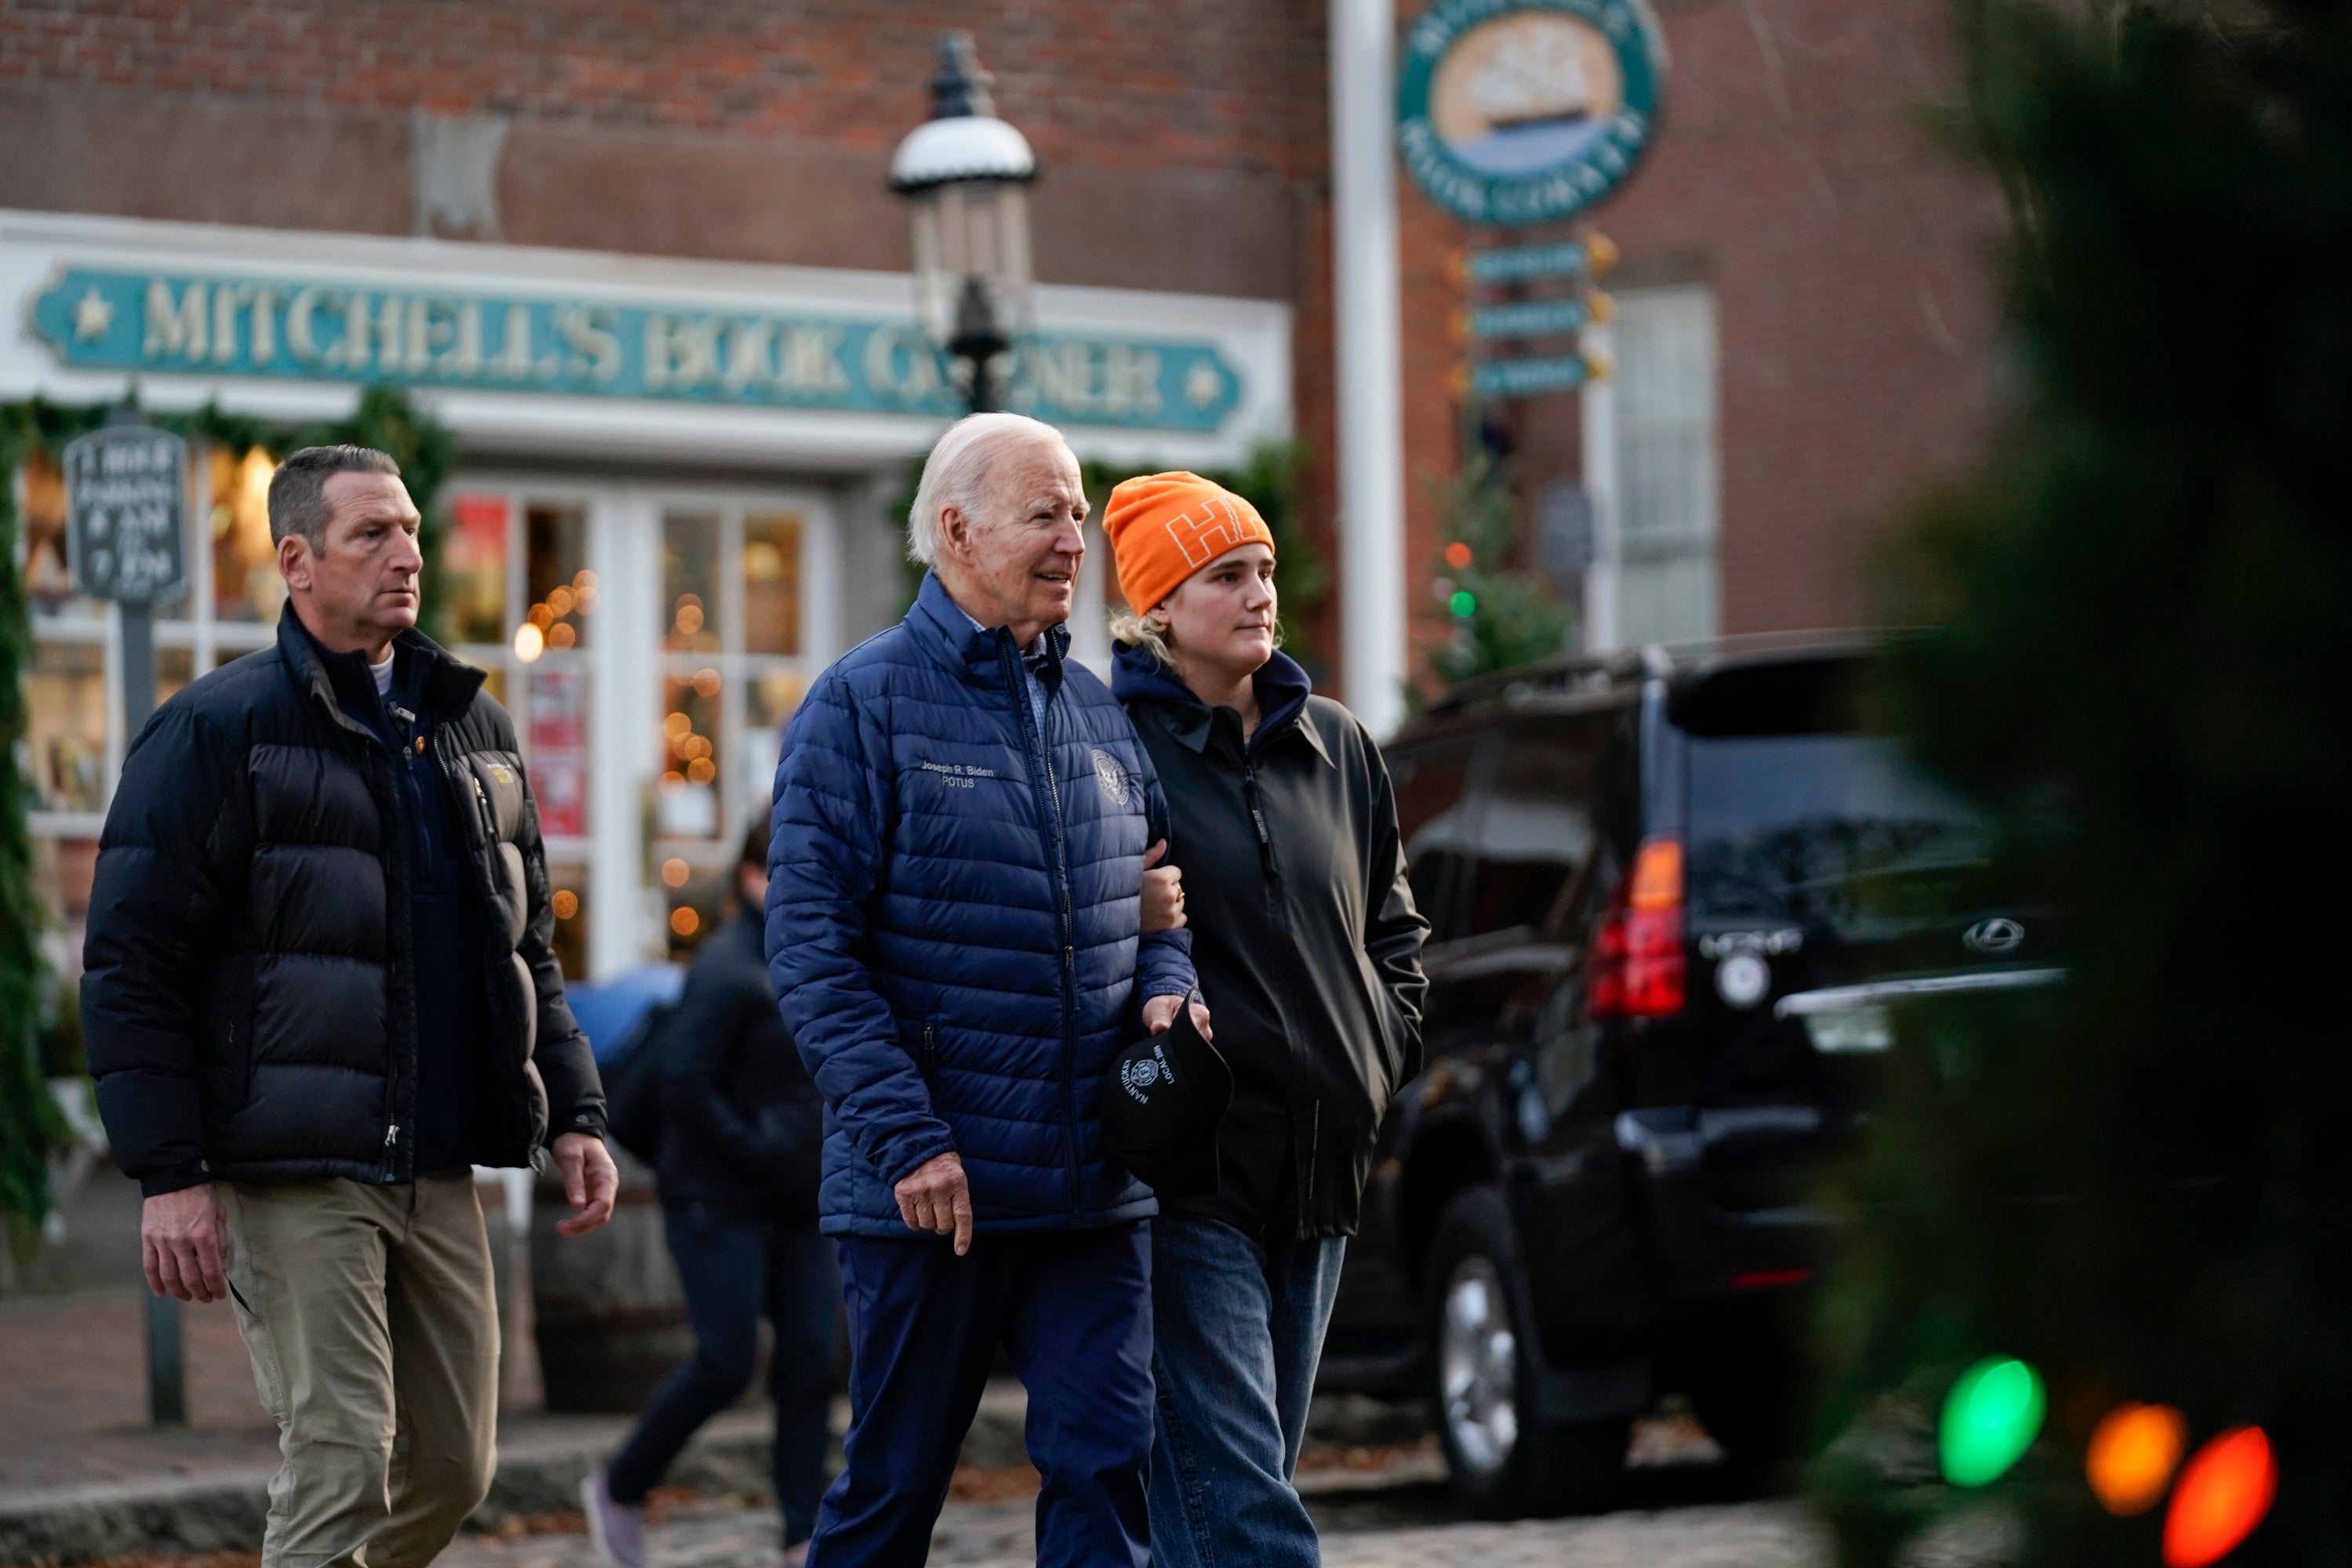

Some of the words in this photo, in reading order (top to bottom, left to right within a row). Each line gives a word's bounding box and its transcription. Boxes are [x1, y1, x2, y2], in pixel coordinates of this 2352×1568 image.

[143, 278, 624, 384] MITCHELL'S
[641, 314, 851, 390] BOOK
[921, 760, 953, 775] Joseph
[953, 764, 965, 775] R.
[966, 765, 994, 777] Biden
[942, 775, 975, 788] POTUS
[1120, 1058, 1149, 1105] NANTUCKET
[1159, 1058, 1175, 1085] LOCAL
